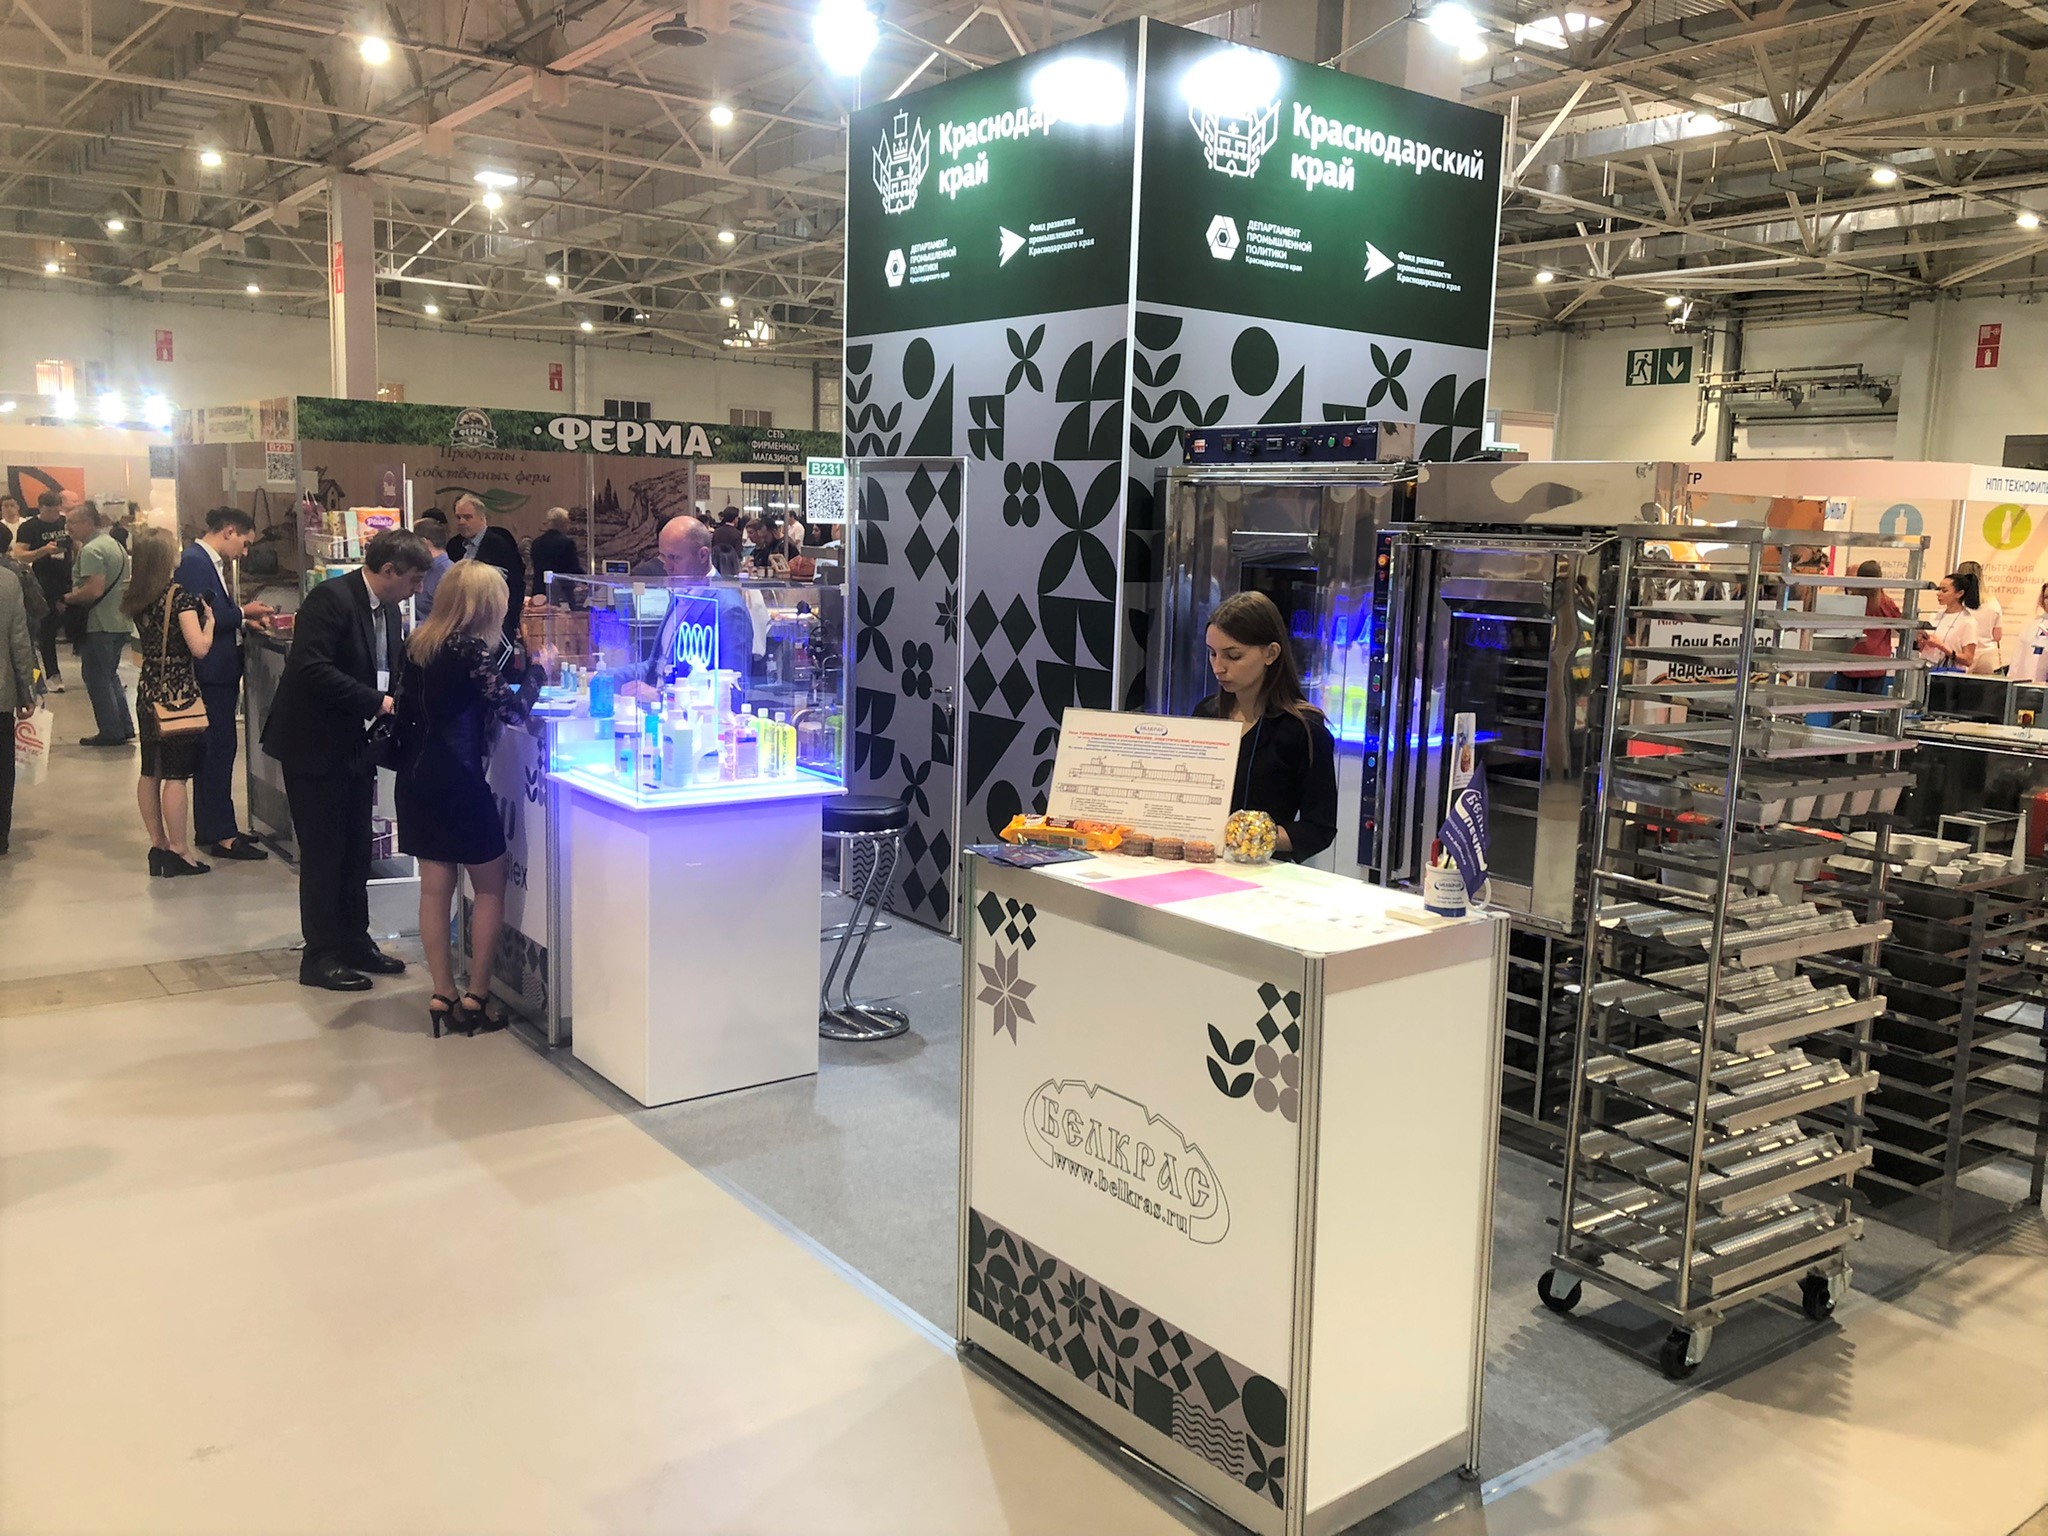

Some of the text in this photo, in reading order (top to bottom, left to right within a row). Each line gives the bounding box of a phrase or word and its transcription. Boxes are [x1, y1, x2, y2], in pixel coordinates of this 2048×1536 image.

[938, 103, 1058, 160] Краснодар
[1292, 101, 1485, 182] Краснодарский
[939, 151, 989, 200] край
[1291, 154, 1355, 191] край
[1247, 220, 1301, 238] ДЕПАРТАМЕНТ
[1029, 241, 1078, 257] Краснодарского
[1246, 232, 1312, 252] ПРОМЫШЛЕННОЙ
[1246, 244, 1288, 260] ПОЛИТИКИ
[458, 430, 488, 438] ФЕРМА
[547, 416, 713, 458] ФЕРМА
[767, 429, 785, 439] СЕТЬ
[751, 440, 801, 452] ФИРМЕННЫХ
[752, 453, 798, 463] МАГАЗИНОВ
[415, 465, 551, 486] собственных ферм
[811, 463, 841, 475] B231
[1986, 478, 2003, 491] НПП
[1041, 1094, 1210, 1208] БЕЛКРАС
[1055, 1151, 1187, 1235] www.belkras.ru
